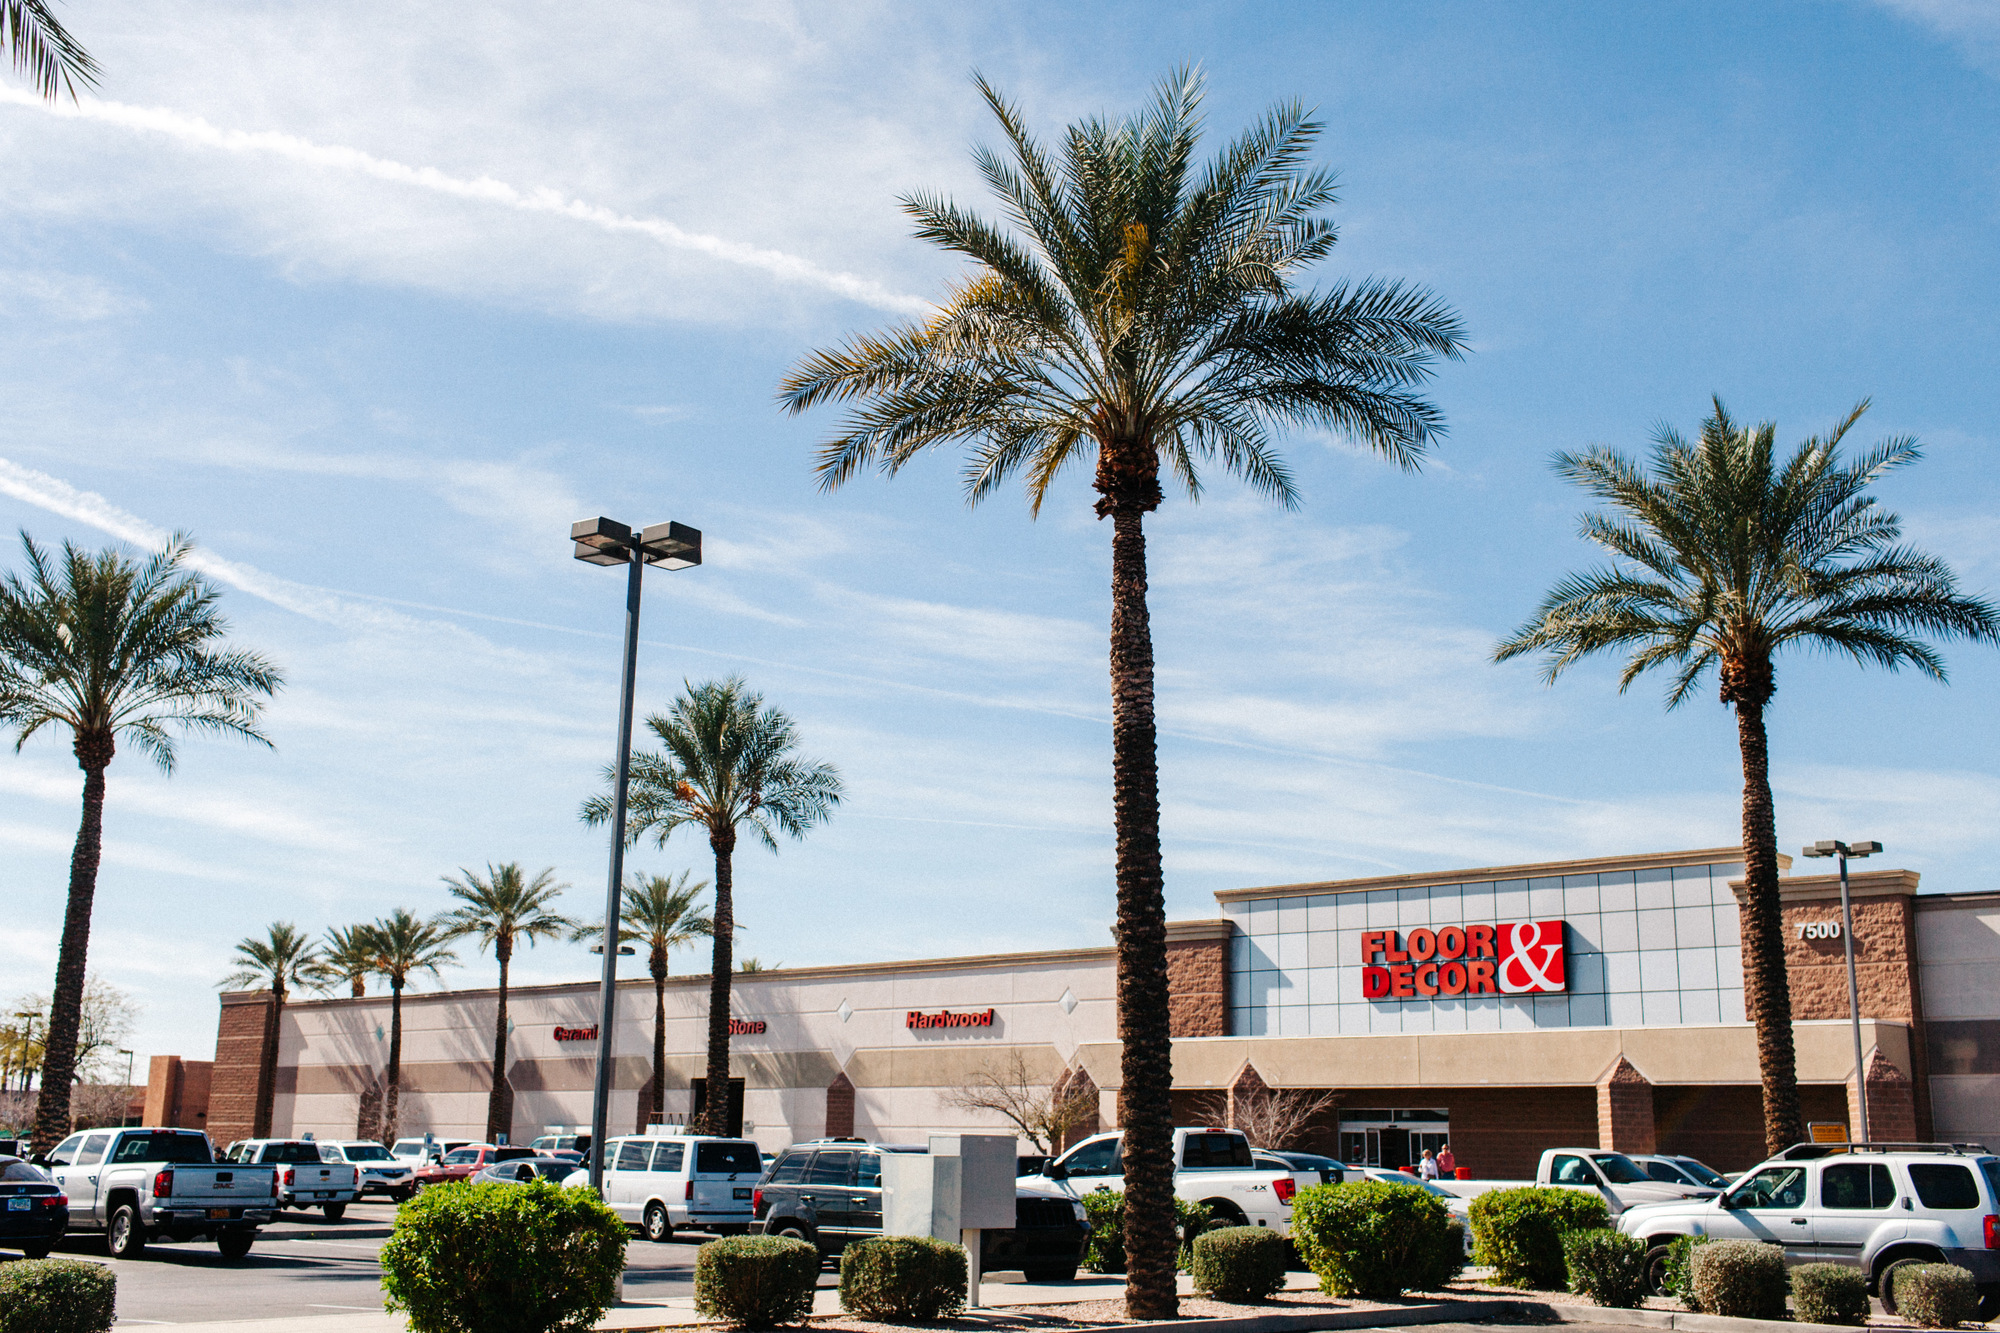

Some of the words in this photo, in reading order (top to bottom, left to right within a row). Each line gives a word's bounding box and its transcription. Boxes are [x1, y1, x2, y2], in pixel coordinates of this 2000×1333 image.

[1794, 922, 1840, 939] 7500
[1361, 924, 1496, 963] FLOOR
[1498, 921, 1566, 994] &
[1362, 960, 1497, 998] DECOR
[728, 1019, 767, 1035] Stone
[906, 1008, 994, 1028] Hardwood
[553, 1024, 599, 1041] Cerami
